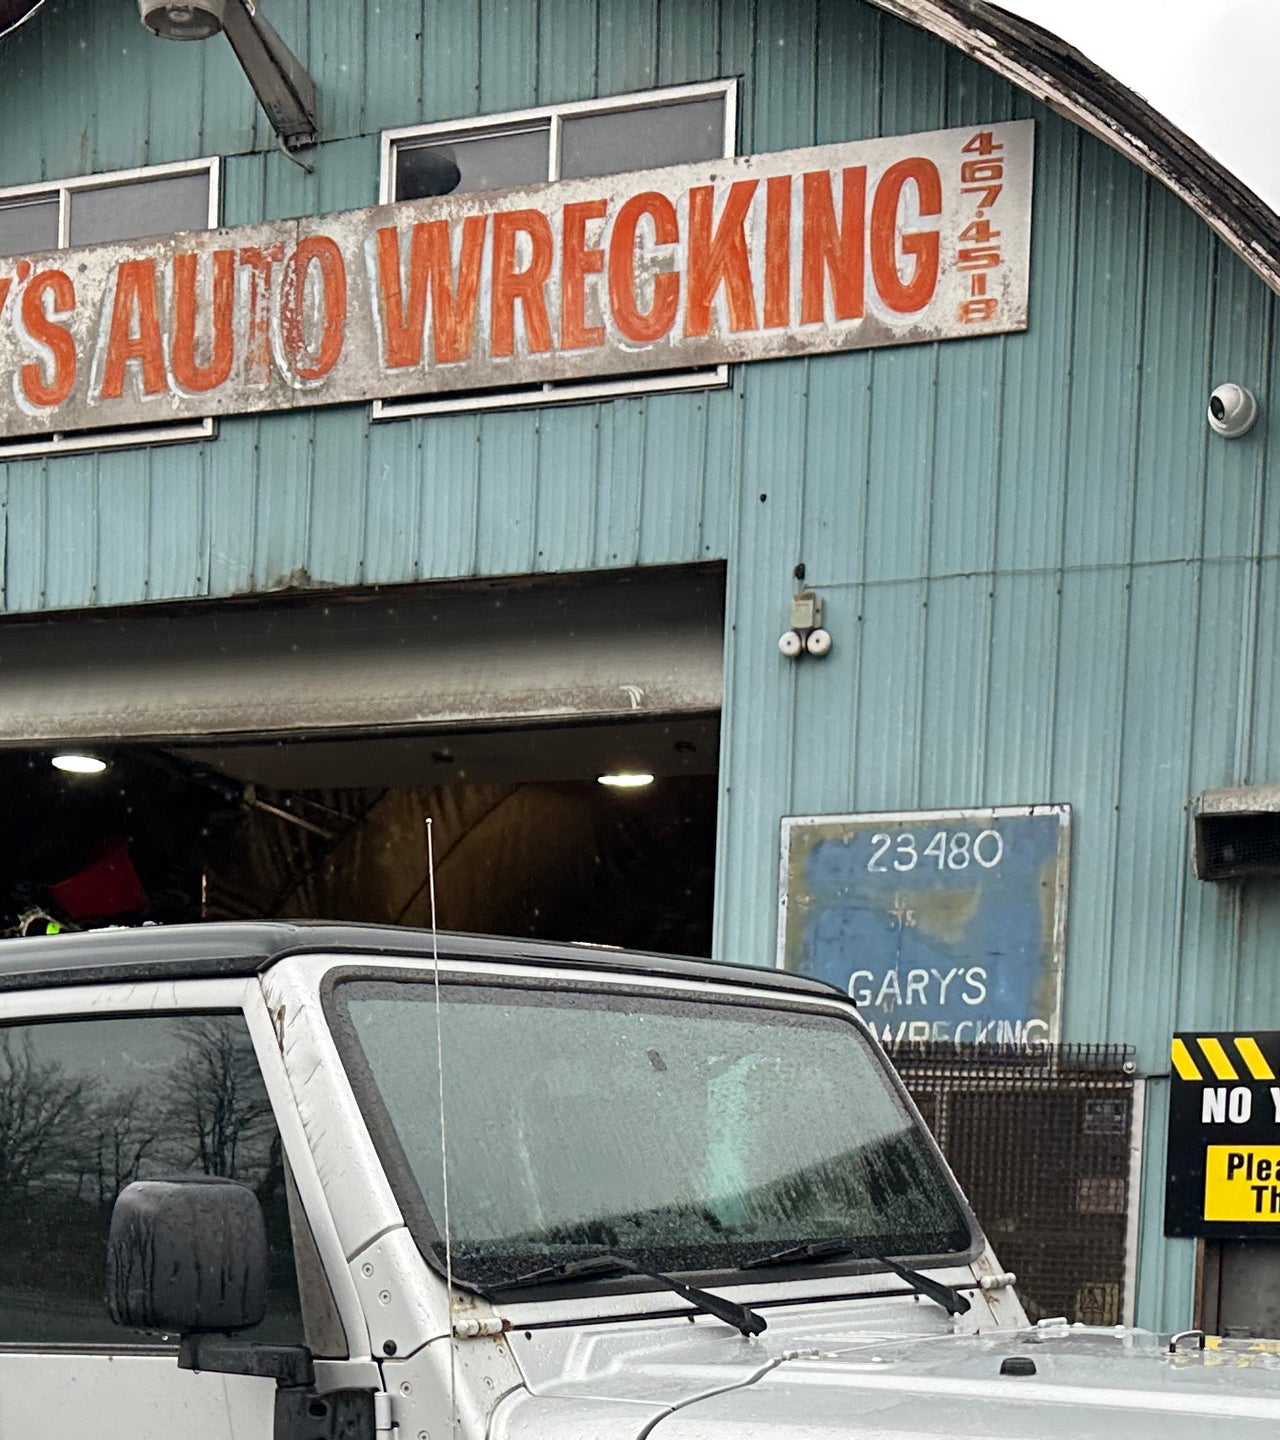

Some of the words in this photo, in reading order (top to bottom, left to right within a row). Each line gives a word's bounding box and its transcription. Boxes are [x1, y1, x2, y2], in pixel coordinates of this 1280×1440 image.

[101, 235, 348, 401] AUTO
[376, 156, 943, 369] WRECKING
[867, 829, 1004, 873] 23480
[847, 966, 988, 1008] GARY'S
[1201, 1085, 1253, 1125] NO
